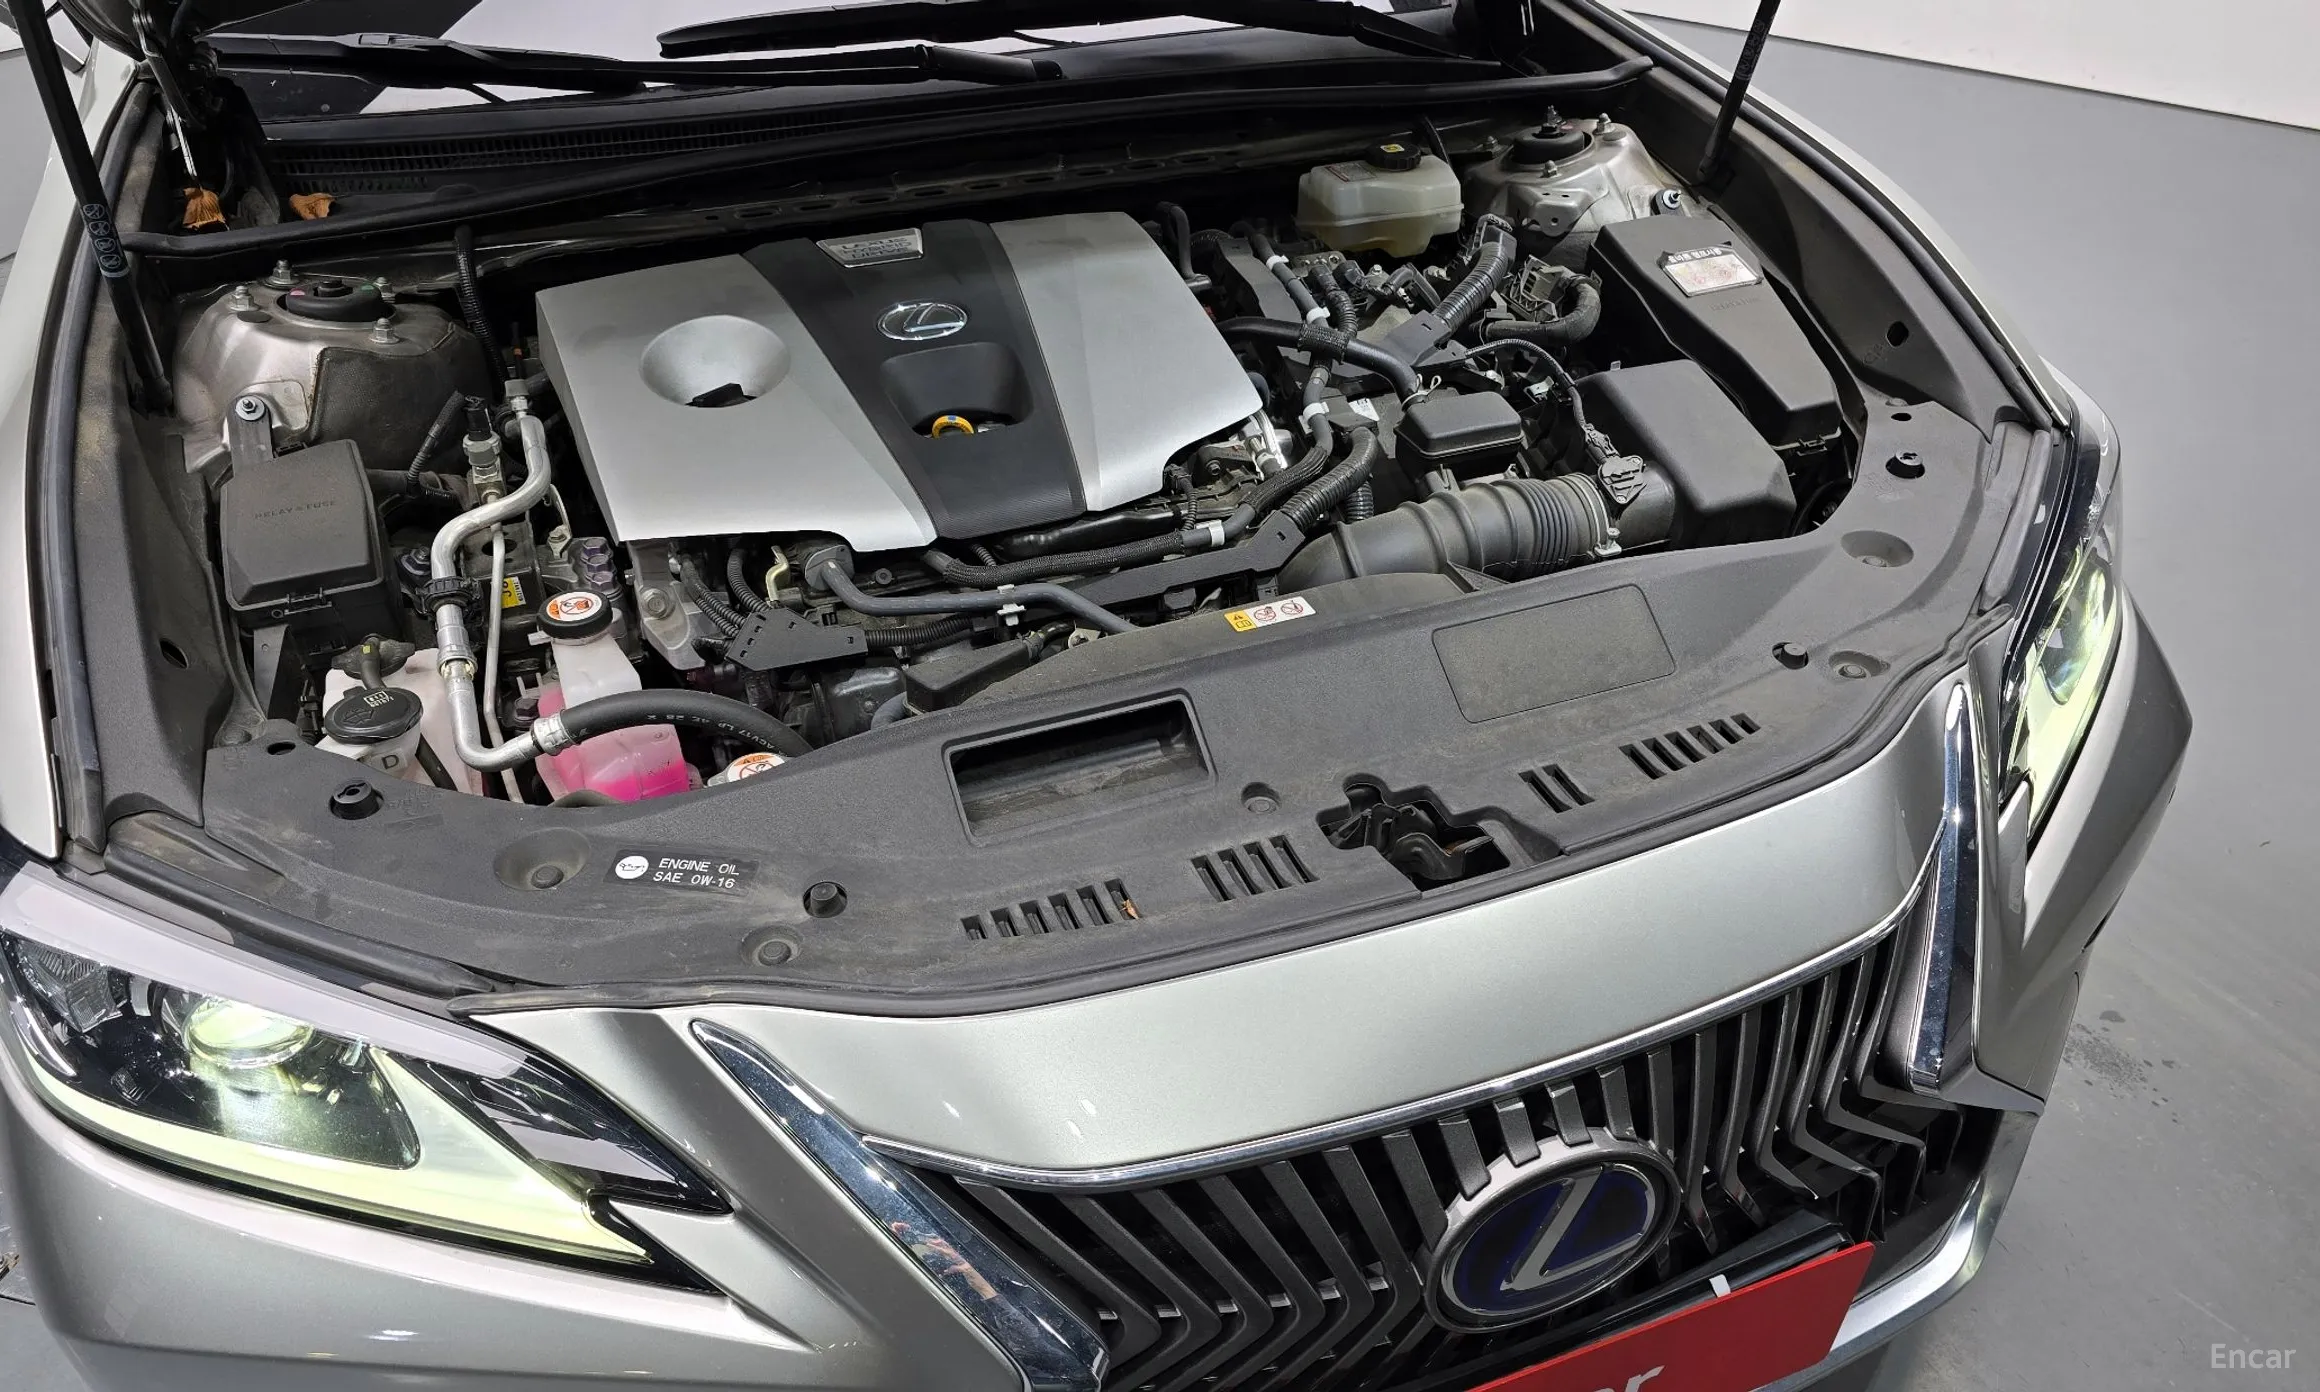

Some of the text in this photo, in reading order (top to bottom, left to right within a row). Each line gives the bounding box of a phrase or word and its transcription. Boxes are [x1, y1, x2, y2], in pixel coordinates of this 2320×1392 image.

[381, 754, 400, 770] D
[658, 857, 740, 876] ENGINE OIL
[652, 871, 736, 889] SAE 0W-16
